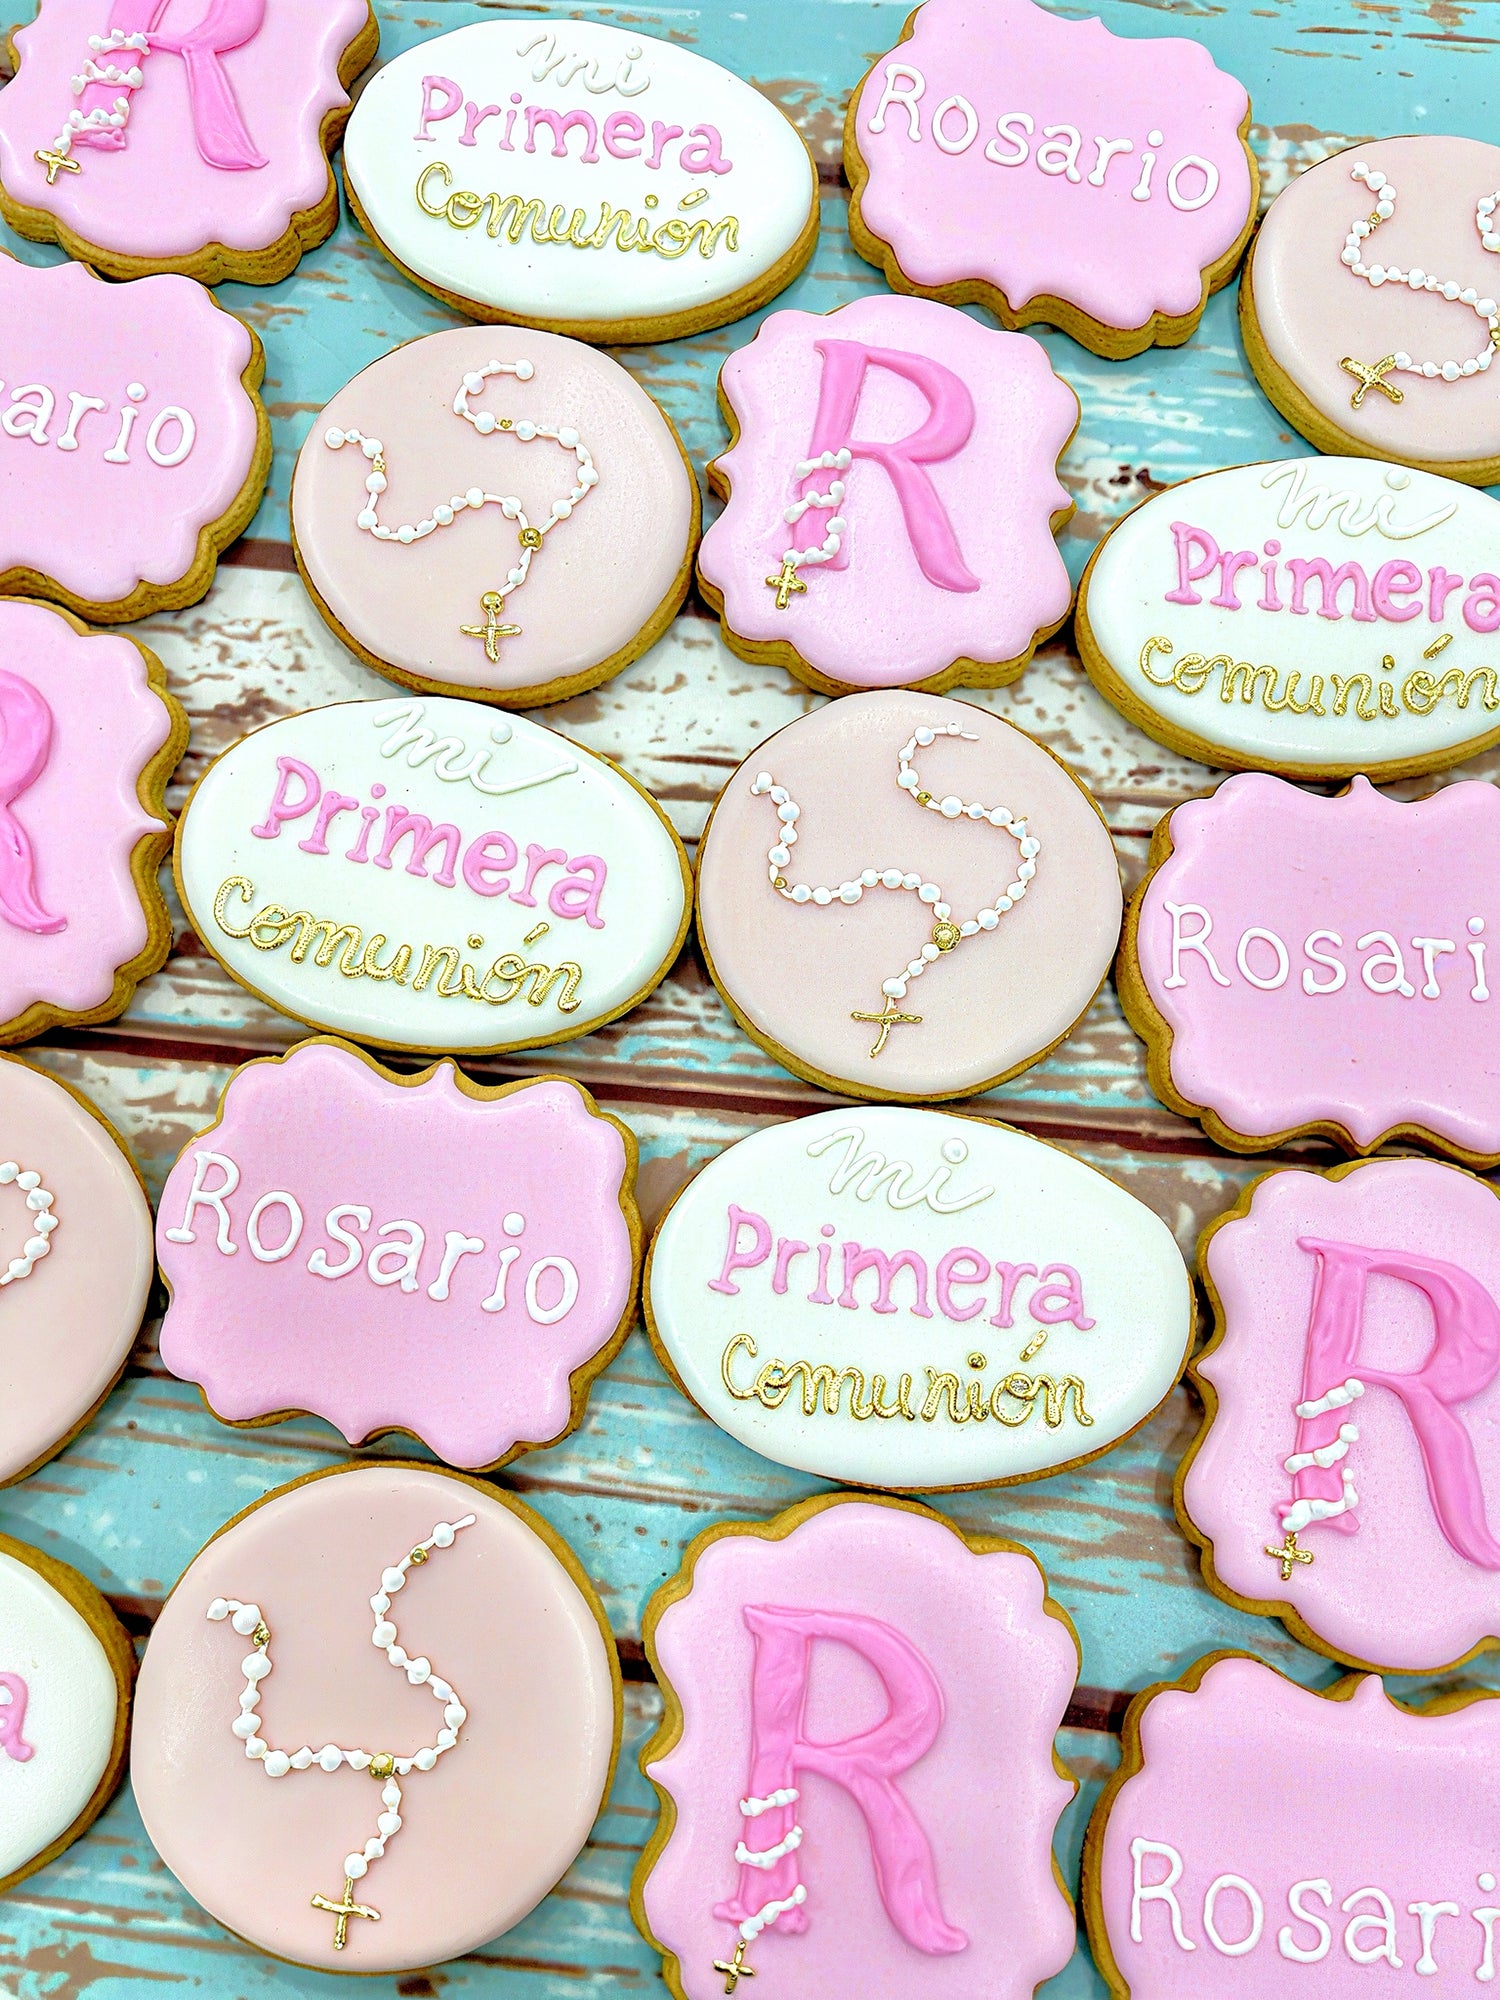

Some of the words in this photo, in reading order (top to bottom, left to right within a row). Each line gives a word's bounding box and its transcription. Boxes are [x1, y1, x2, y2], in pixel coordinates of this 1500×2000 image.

[413, 75, 734, 175] Primera
[868, 62, 1220, 211] Rosario
[415, 161, 740, 259] Comunión
[0, 379, 197, 468] ario
[780, 338, 981, 593] R
[250, 755, 607, 930] Primera
[213, 875, 583, 1015] Comunión
[1163, 901, 1491, 1003] Rosari
[164, 1151, 580, 1324] Rosario
[707, 1203, 1097, 1331] Primera
[721, 1332, 1095, 1429] Comunión
[1275, 1236, 1500, 1572] R
[713, 1604, 972, 1956] R
[1129, 1838, 1500, 1983] Rosari
